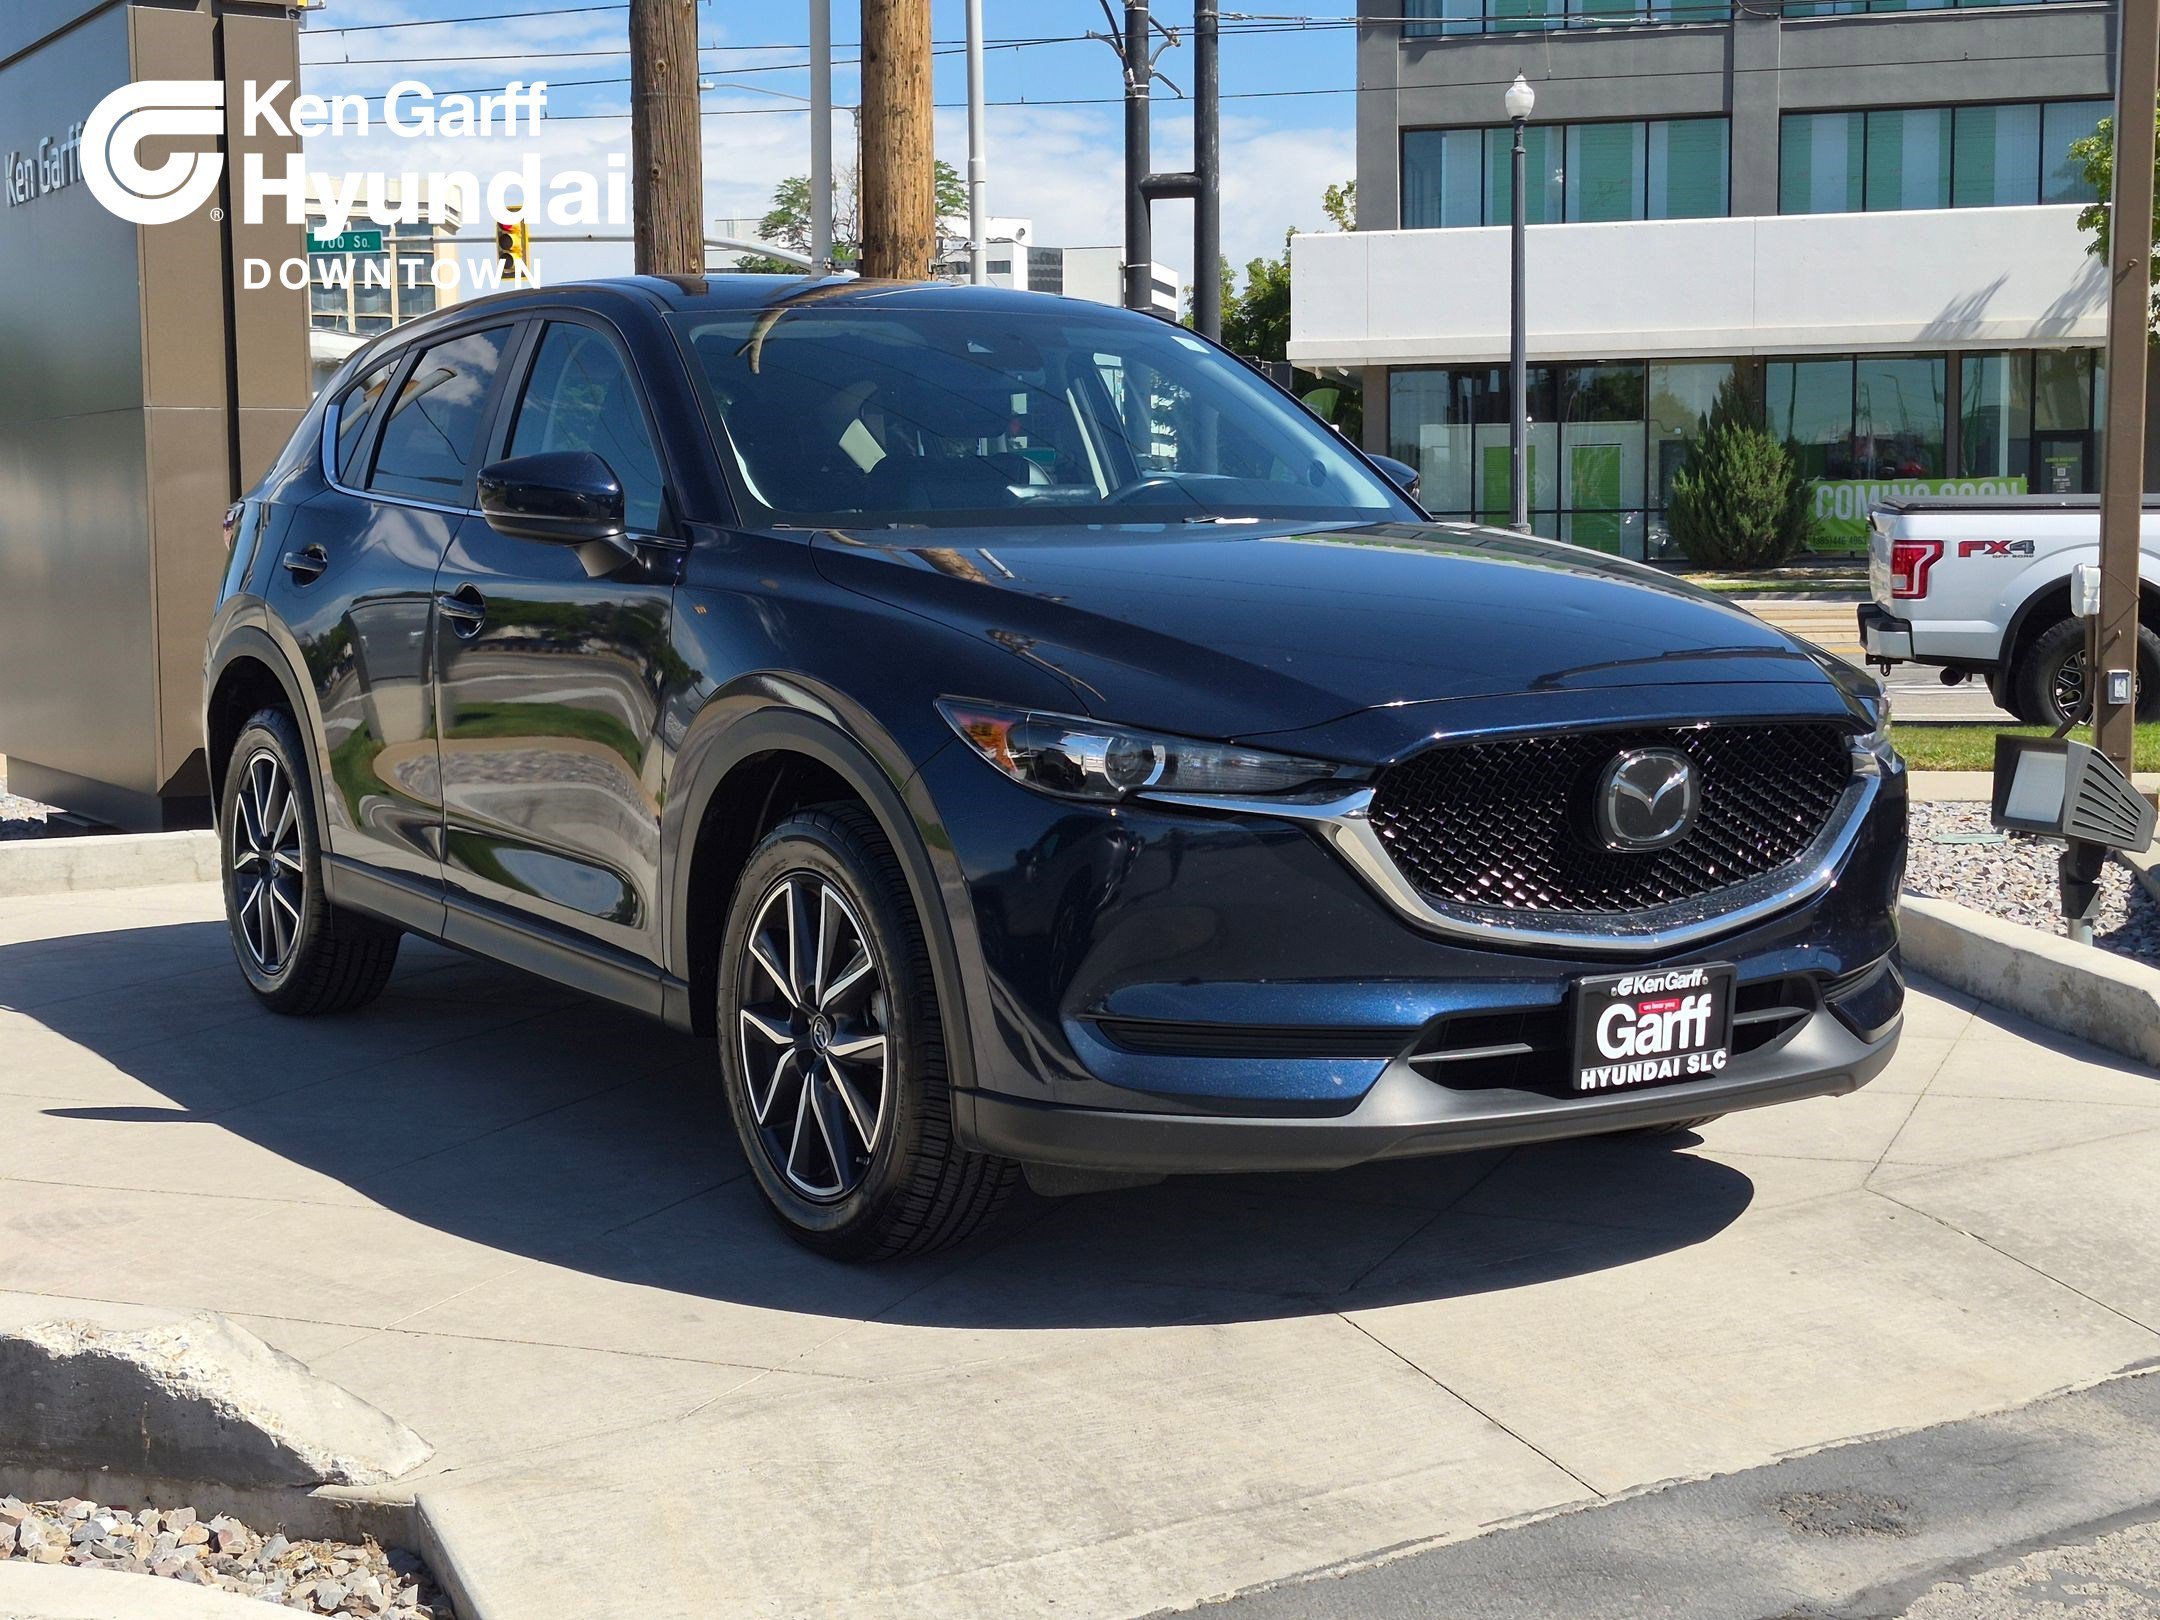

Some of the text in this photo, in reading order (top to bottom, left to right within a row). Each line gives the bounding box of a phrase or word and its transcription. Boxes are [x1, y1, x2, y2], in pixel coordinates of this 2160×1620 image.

[4, 151, 35, 207] Ken
[1958, 540, 2035, 558] FX4
[1633, 968, 1704, 994] Ken Garff
[1664, 1001, 1676, 1010] you
[1596, 993, 1712, 1059] Garff
[1580, 1050, 1727, 1090] HYUNDAI SLC
